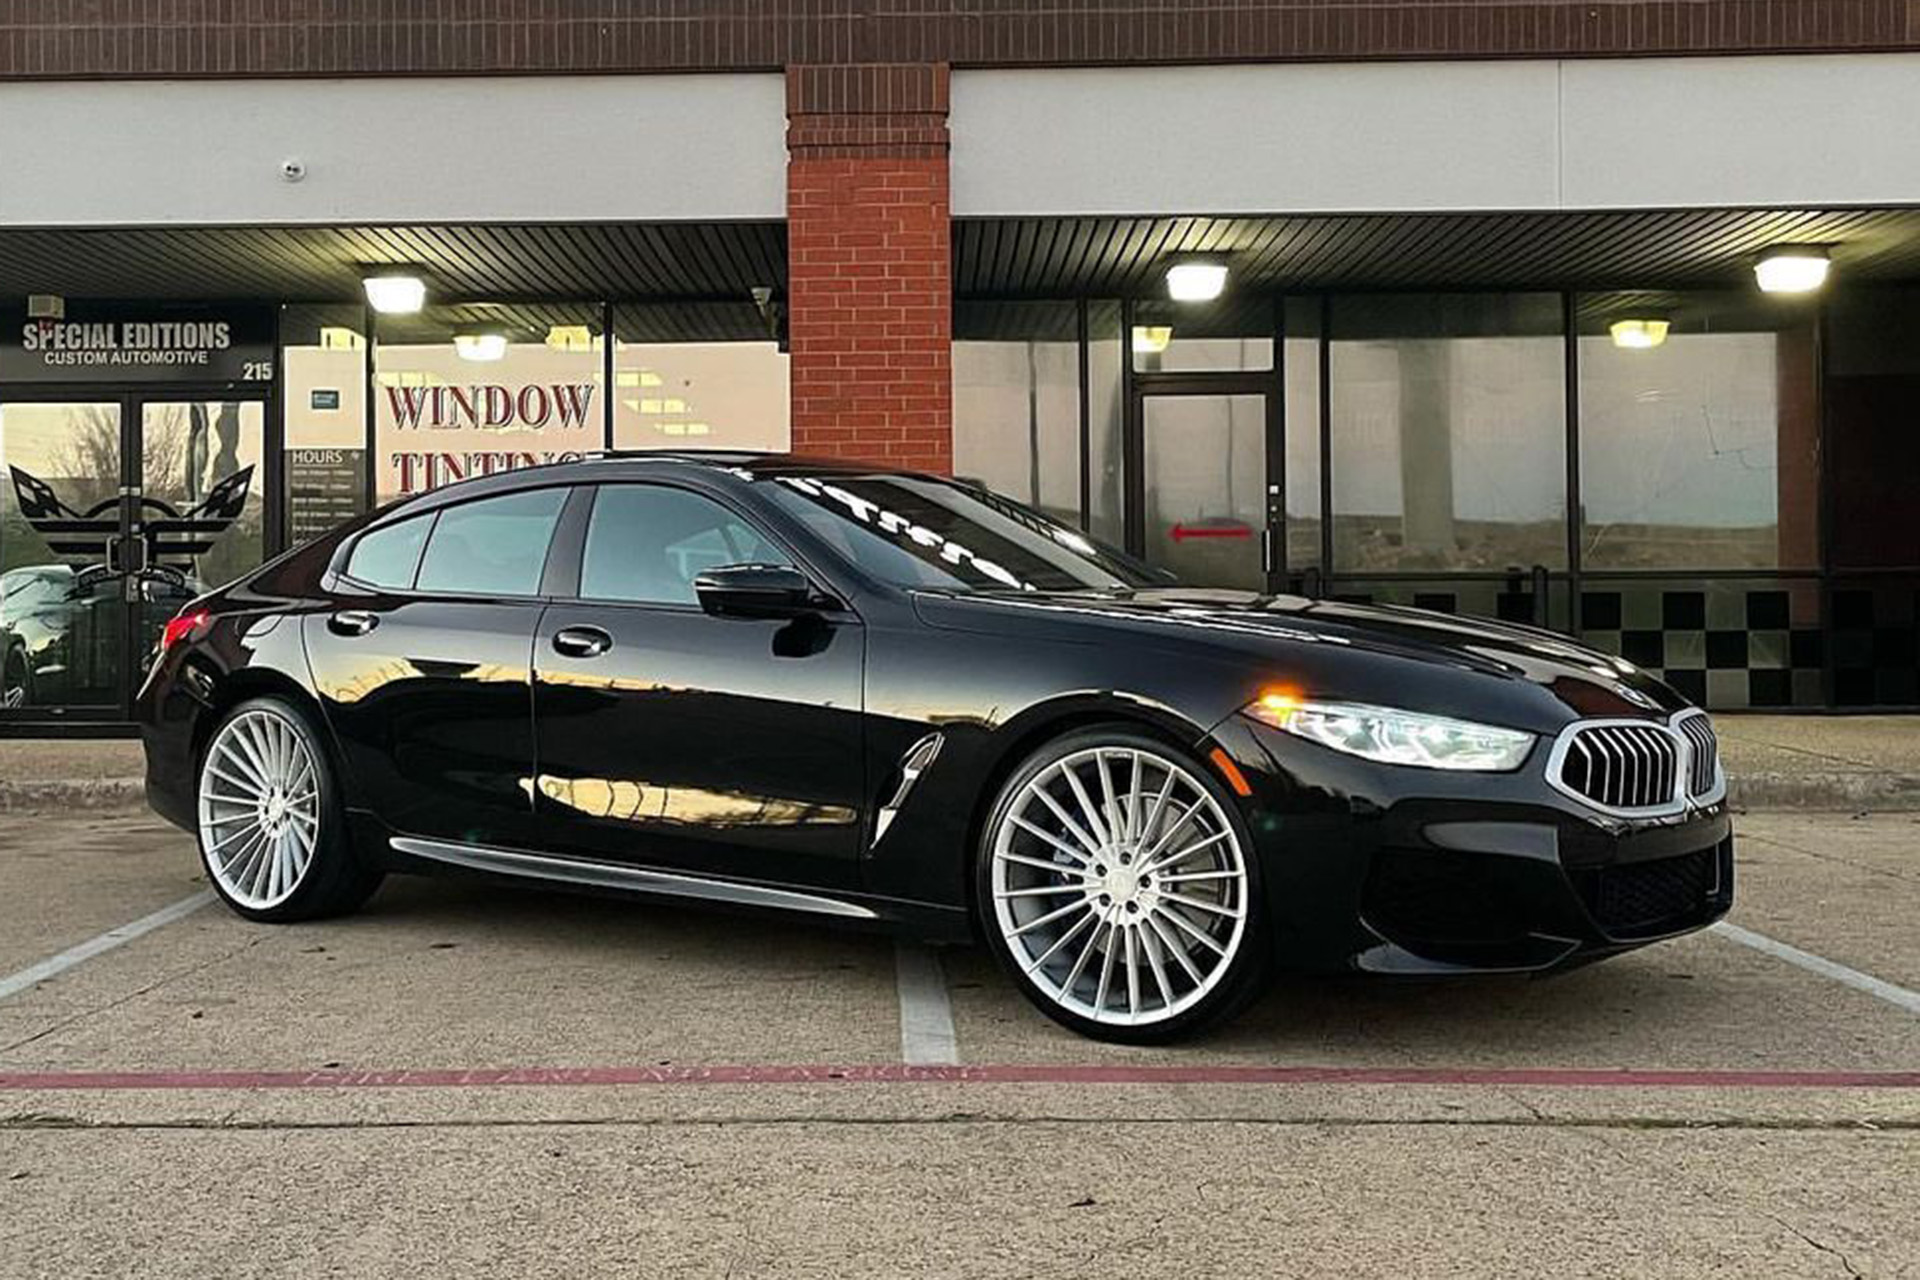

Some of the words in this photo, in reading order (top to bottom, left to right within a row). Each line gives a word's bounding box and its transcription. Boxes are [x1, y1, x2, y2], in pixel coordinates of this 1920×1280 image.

[23, 323, 117, 350] SPECIAL
[122, 322, 231, 349] EDITIONS
[44, 351, 108, 364] CUSTOM
[110, 351, 208, 364] AUTOMOTIVE
[243, 362, 272, 380] 215
[385, 384, 595, 429] WINDOW
[292, 450, 344, 464] HOURS
[391, 452, 582, 493] TINTI
